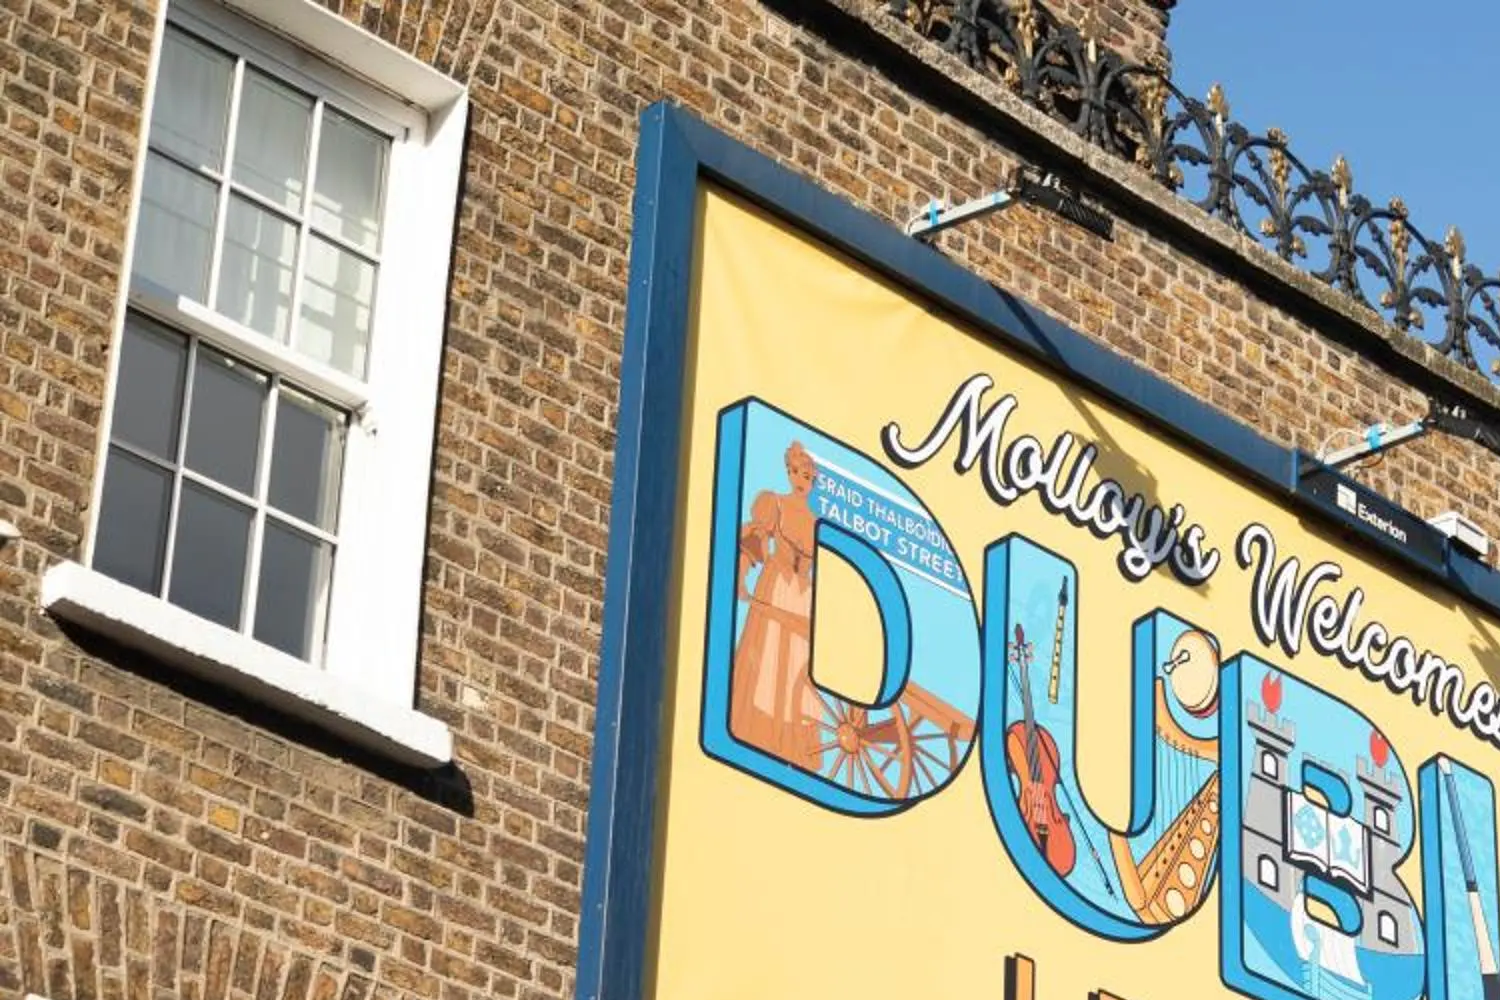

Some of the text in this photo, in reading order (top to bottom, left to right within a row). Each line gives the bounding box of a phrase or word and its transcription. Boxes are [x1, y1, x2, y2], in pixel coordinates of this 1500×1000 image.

[881, 373, 1220, 584] Molloy's
[818, 495, 892, 546] TALBOT
[1357, 503, 1408, 544] Exterion
